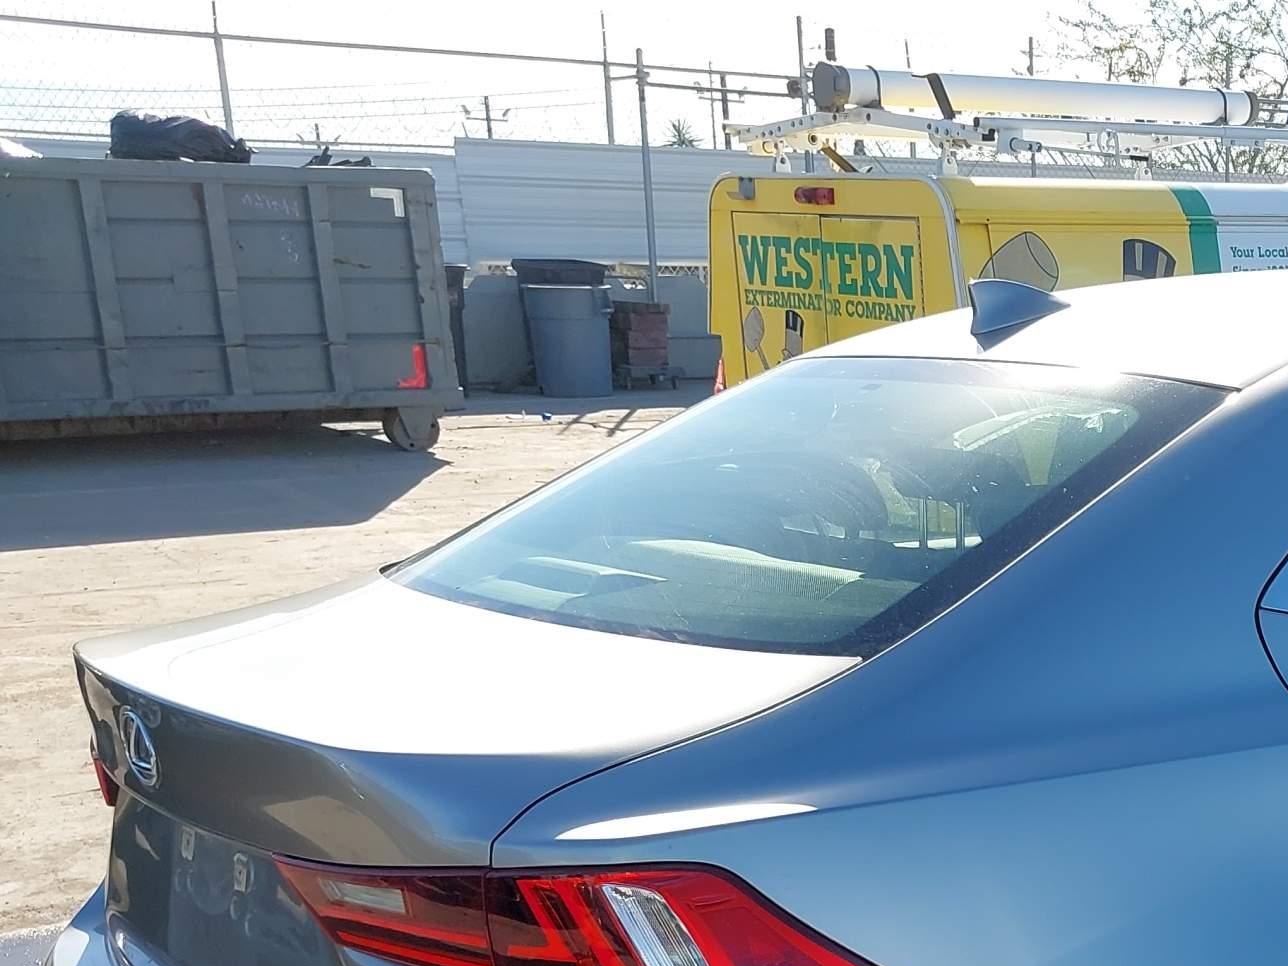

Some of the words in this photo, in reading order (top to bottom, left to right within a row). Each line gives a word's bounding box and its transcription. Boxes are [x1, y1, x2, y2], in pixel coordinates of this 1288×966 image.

[738, 234, 914, 300] WESTERN
[1229, 246, 1254, 258] Your
[1257, 246, 1288, 258] Local
[745, 289, 842, 316] EXTERMINATOR
[845, 300, 916, 322] COMPANY
